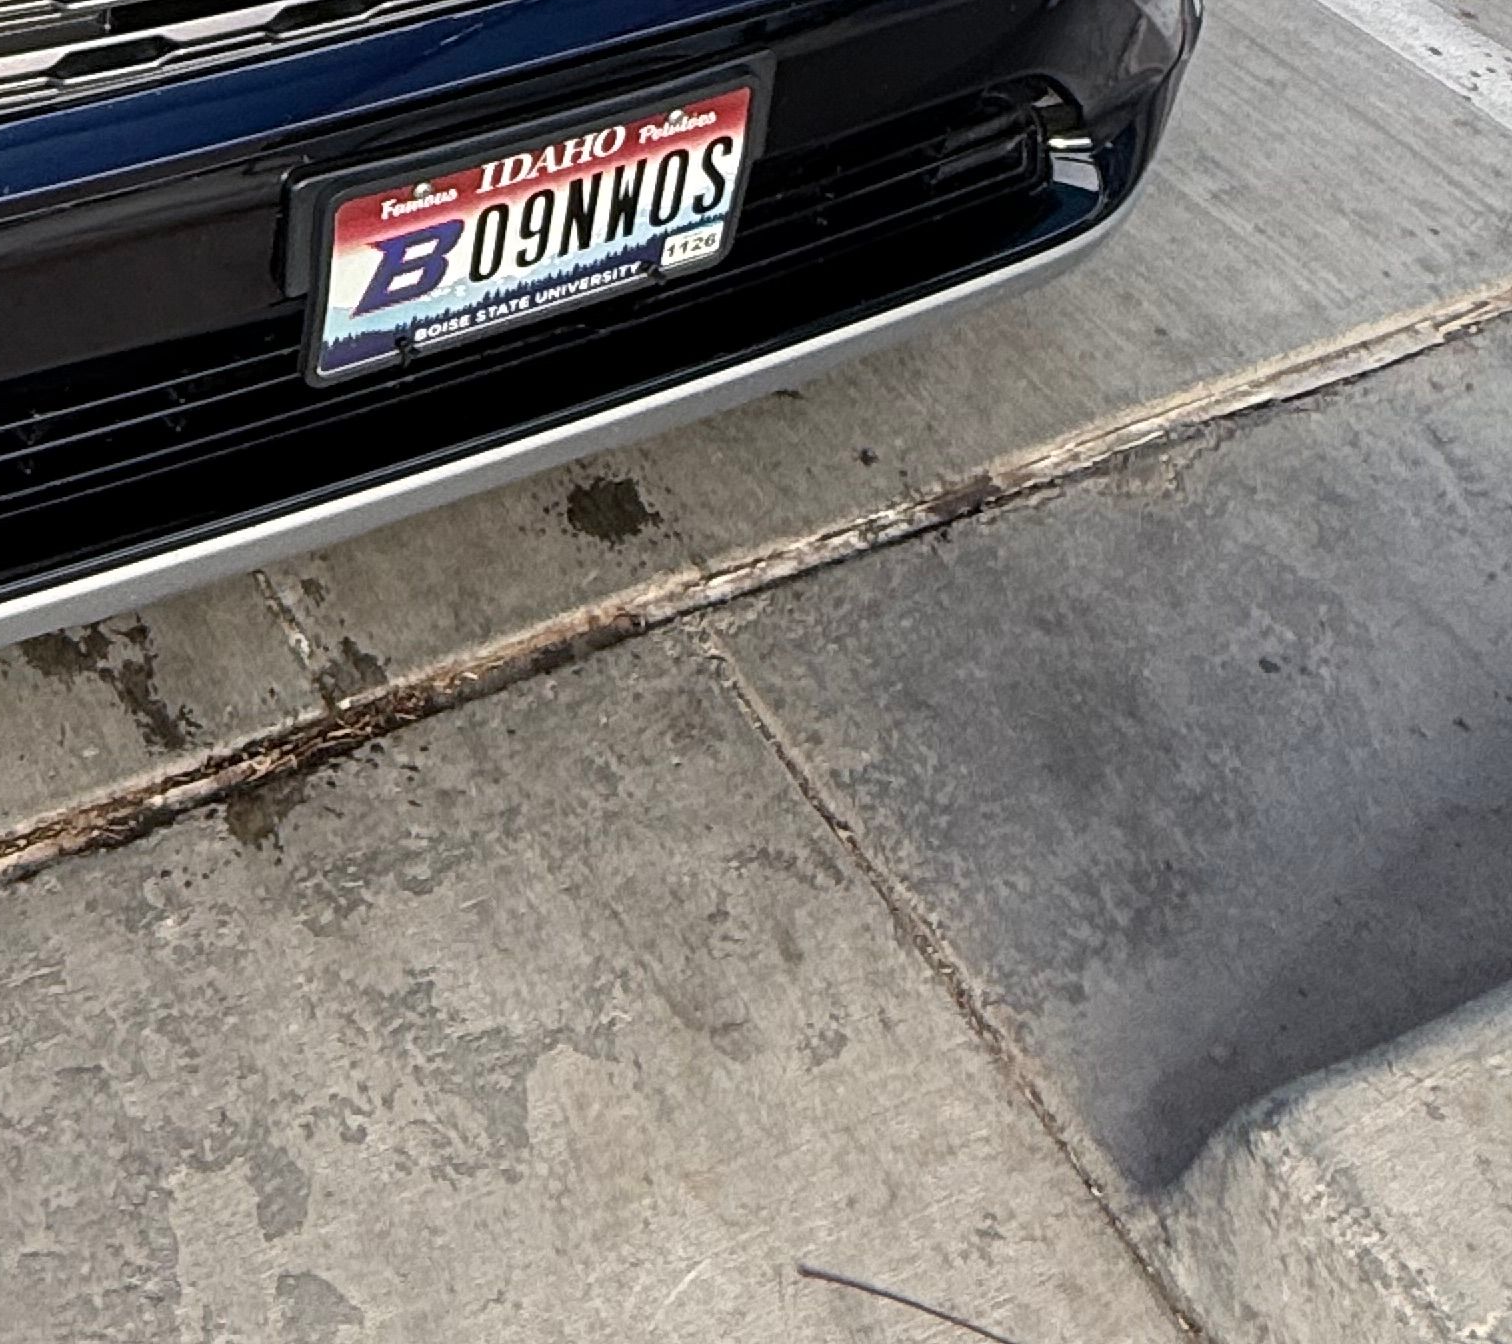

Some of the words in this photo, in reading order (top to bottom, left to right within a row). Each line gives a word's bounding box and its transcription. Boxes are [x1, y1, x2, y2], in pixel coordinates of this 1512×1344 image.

[380, 188, 458, 220] Famous
[475, 125, 626, 194] IDAHO
[349, 218, 465, 320] B
[666, 232, 717, 258] 1126
[413, 313, 471, 342] BOISE
[474, 295, 531, 324] STATE
[534, 260, 642, 305] UNIVERSITY
